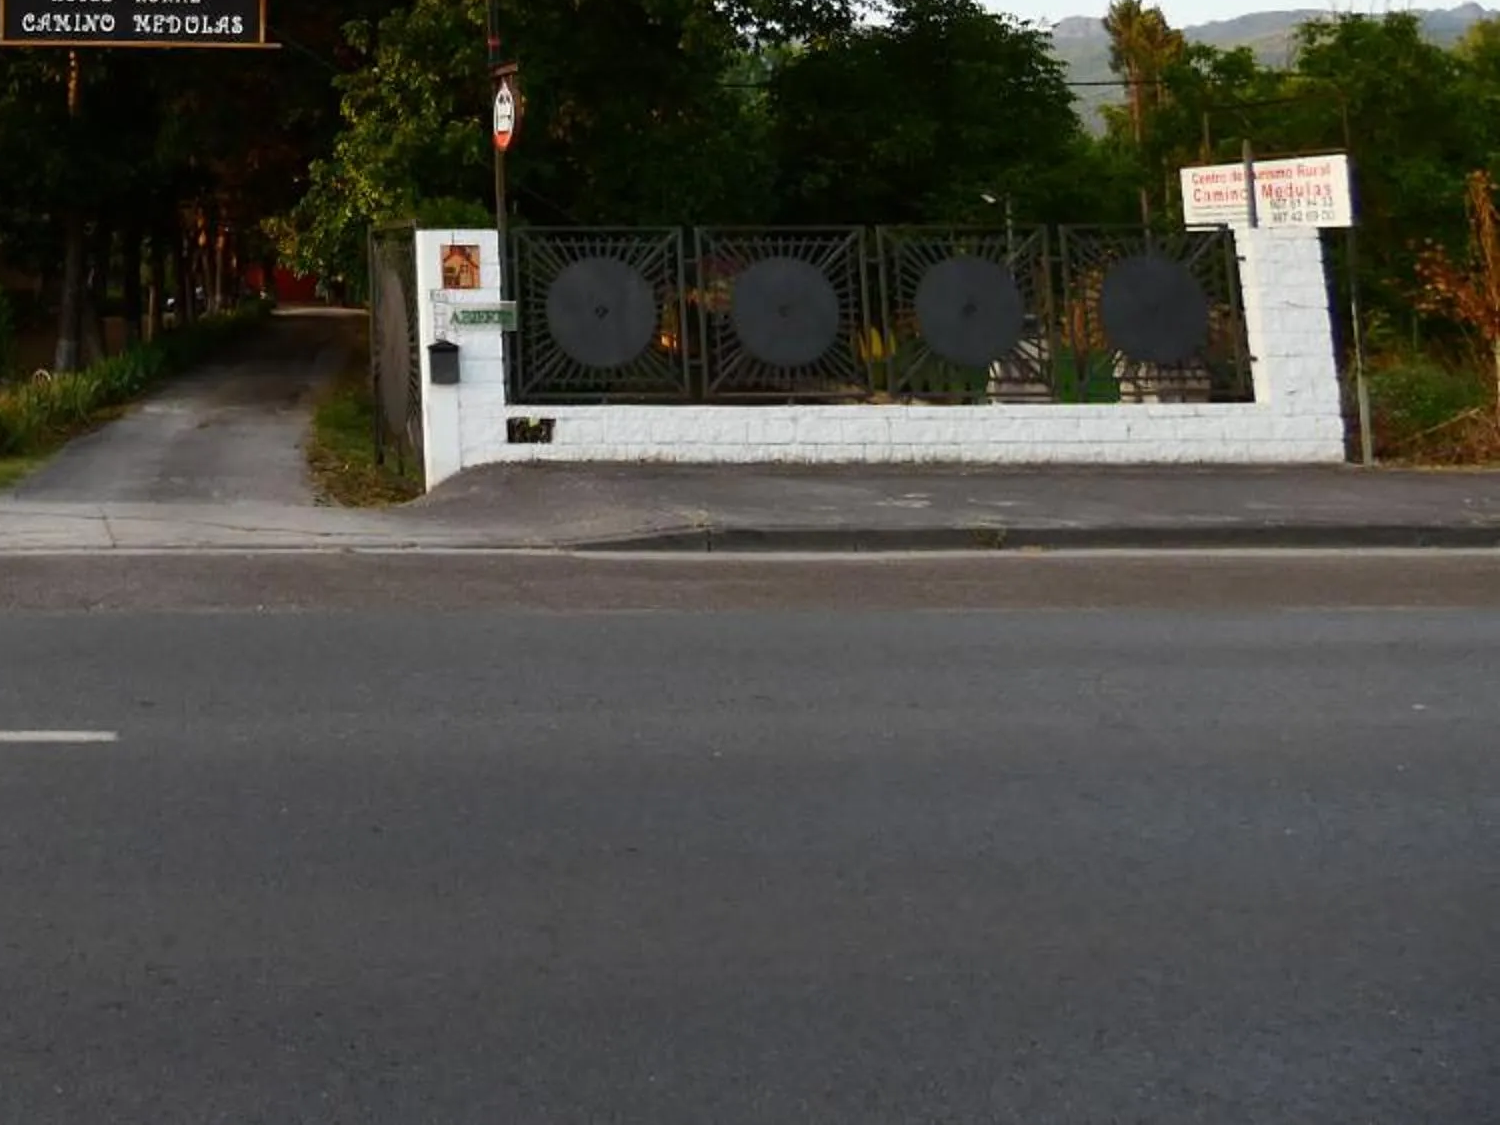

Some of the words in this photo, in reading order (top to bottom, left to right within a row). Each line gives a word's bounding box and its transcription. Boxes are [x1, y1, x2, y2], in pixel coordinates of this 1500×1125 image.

[22, 13, 115, 32] CAMINO
[1192, 171, 1226, 184] Centro
[1297, 162, 1331, 177] Rural
[1261, 181, 1333, 199] Medulas
